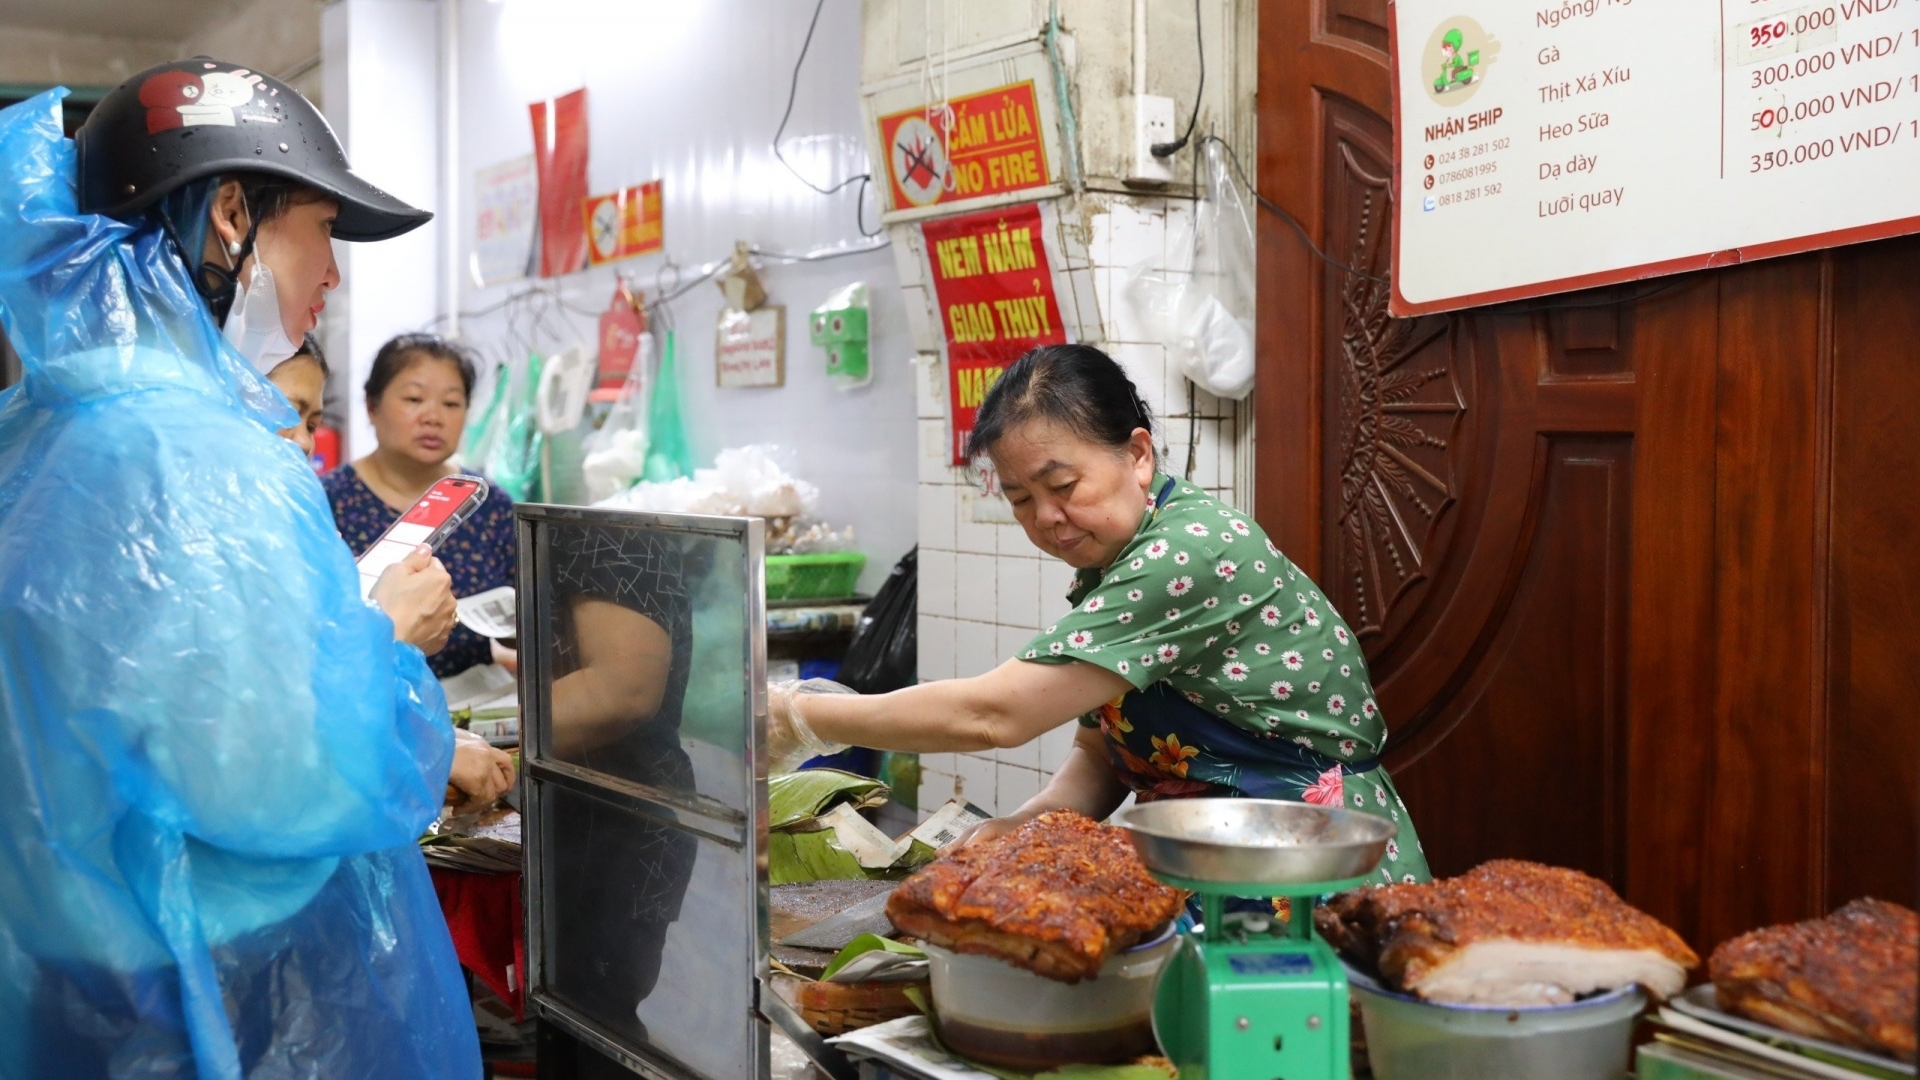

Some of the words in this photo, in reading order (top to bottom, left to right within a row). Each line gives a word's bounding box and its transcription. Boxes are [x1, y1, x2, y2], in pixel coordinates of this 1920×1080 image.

[1750, 7, 1835, 47] 350.000
[1538, 45, 1560, 65] Gà
[1751, 51, 1835, 89] 300.000
[1841, 31, 1903, 65] VND/
[1538, 82, 1571, 103] Thịt
[1575, 72, 1597, 94] Xá
[1602, 66, 1631, 87] Xíu
[990, 95, 1032, 142] LỬA
[1751, 95, 1835, 131] 500.000
[1840, 77, 1902, 109] VND/
[1425, 116, 1464, 142] NHẬN
[1468, 107, 1503, 131] SHIP
[1539, 124, 1573, 142] Heo
[1578, 112, 1609, 132] Sữa
[1438, 151, 1456, 165] 024
[1458, 147, 1470, 160] 38
[1472, 143, 1489, 157] 281
[1492, 137, 1510, 151] 502
[1750, 139, 1834, 173] 350.000
[1839, 122, 1902, 153] VND/
[953, 161, 984, 195] NO
[988, 150, 1040, 190] FIRE
[1439, 161, 1497, 185] 0786081995
[1539, 162, 1561, 180] Dạ
[1566, 154, 1597, 173] dày
[1439, 192, 1462, 206] 0818
[1464, 188, 1481, 201] 281
[1484, 183, 1502, 196] 502
[1538, 193, 1574, 217] Lưỡi
[1579, 187, 1624, 212] quay
[936, 235, 983, 279] NEM
[982, 217, 1036, 274] NẮM
[949, 301, 996, 344] GIAO
